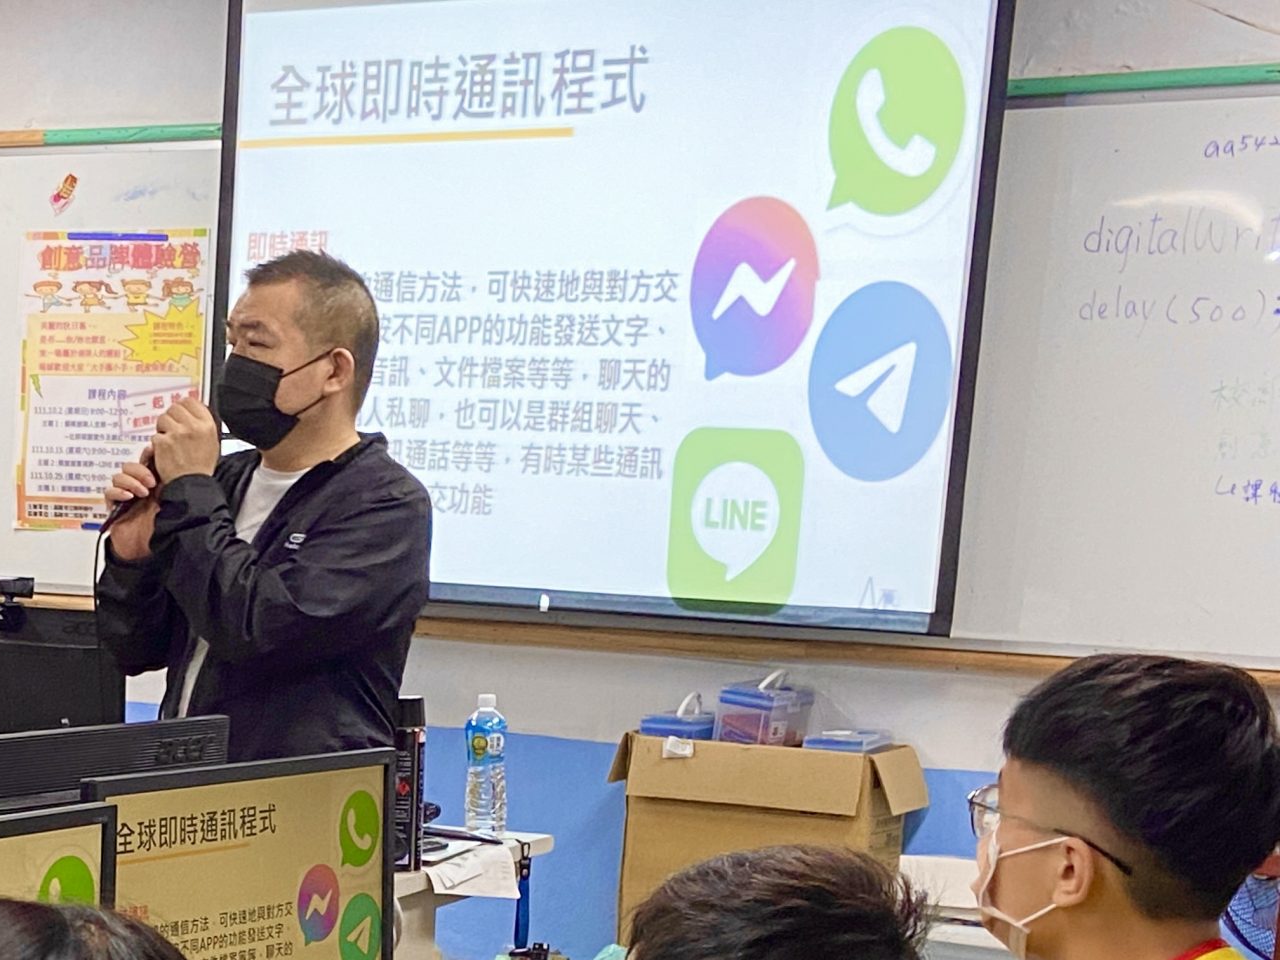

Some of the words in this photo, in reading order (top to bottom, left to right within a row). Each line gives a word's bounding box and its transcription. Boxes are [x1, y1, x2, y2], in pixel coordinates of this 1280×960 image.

[269, 45, 649, 127] 全球即時通訊程式
[357, 397, 660, 436] 人私聊，也可以是群組聊天、
[704, 497, 768, 531] LINE
[116, 803, 277, 855] 全球即時通訊程式
